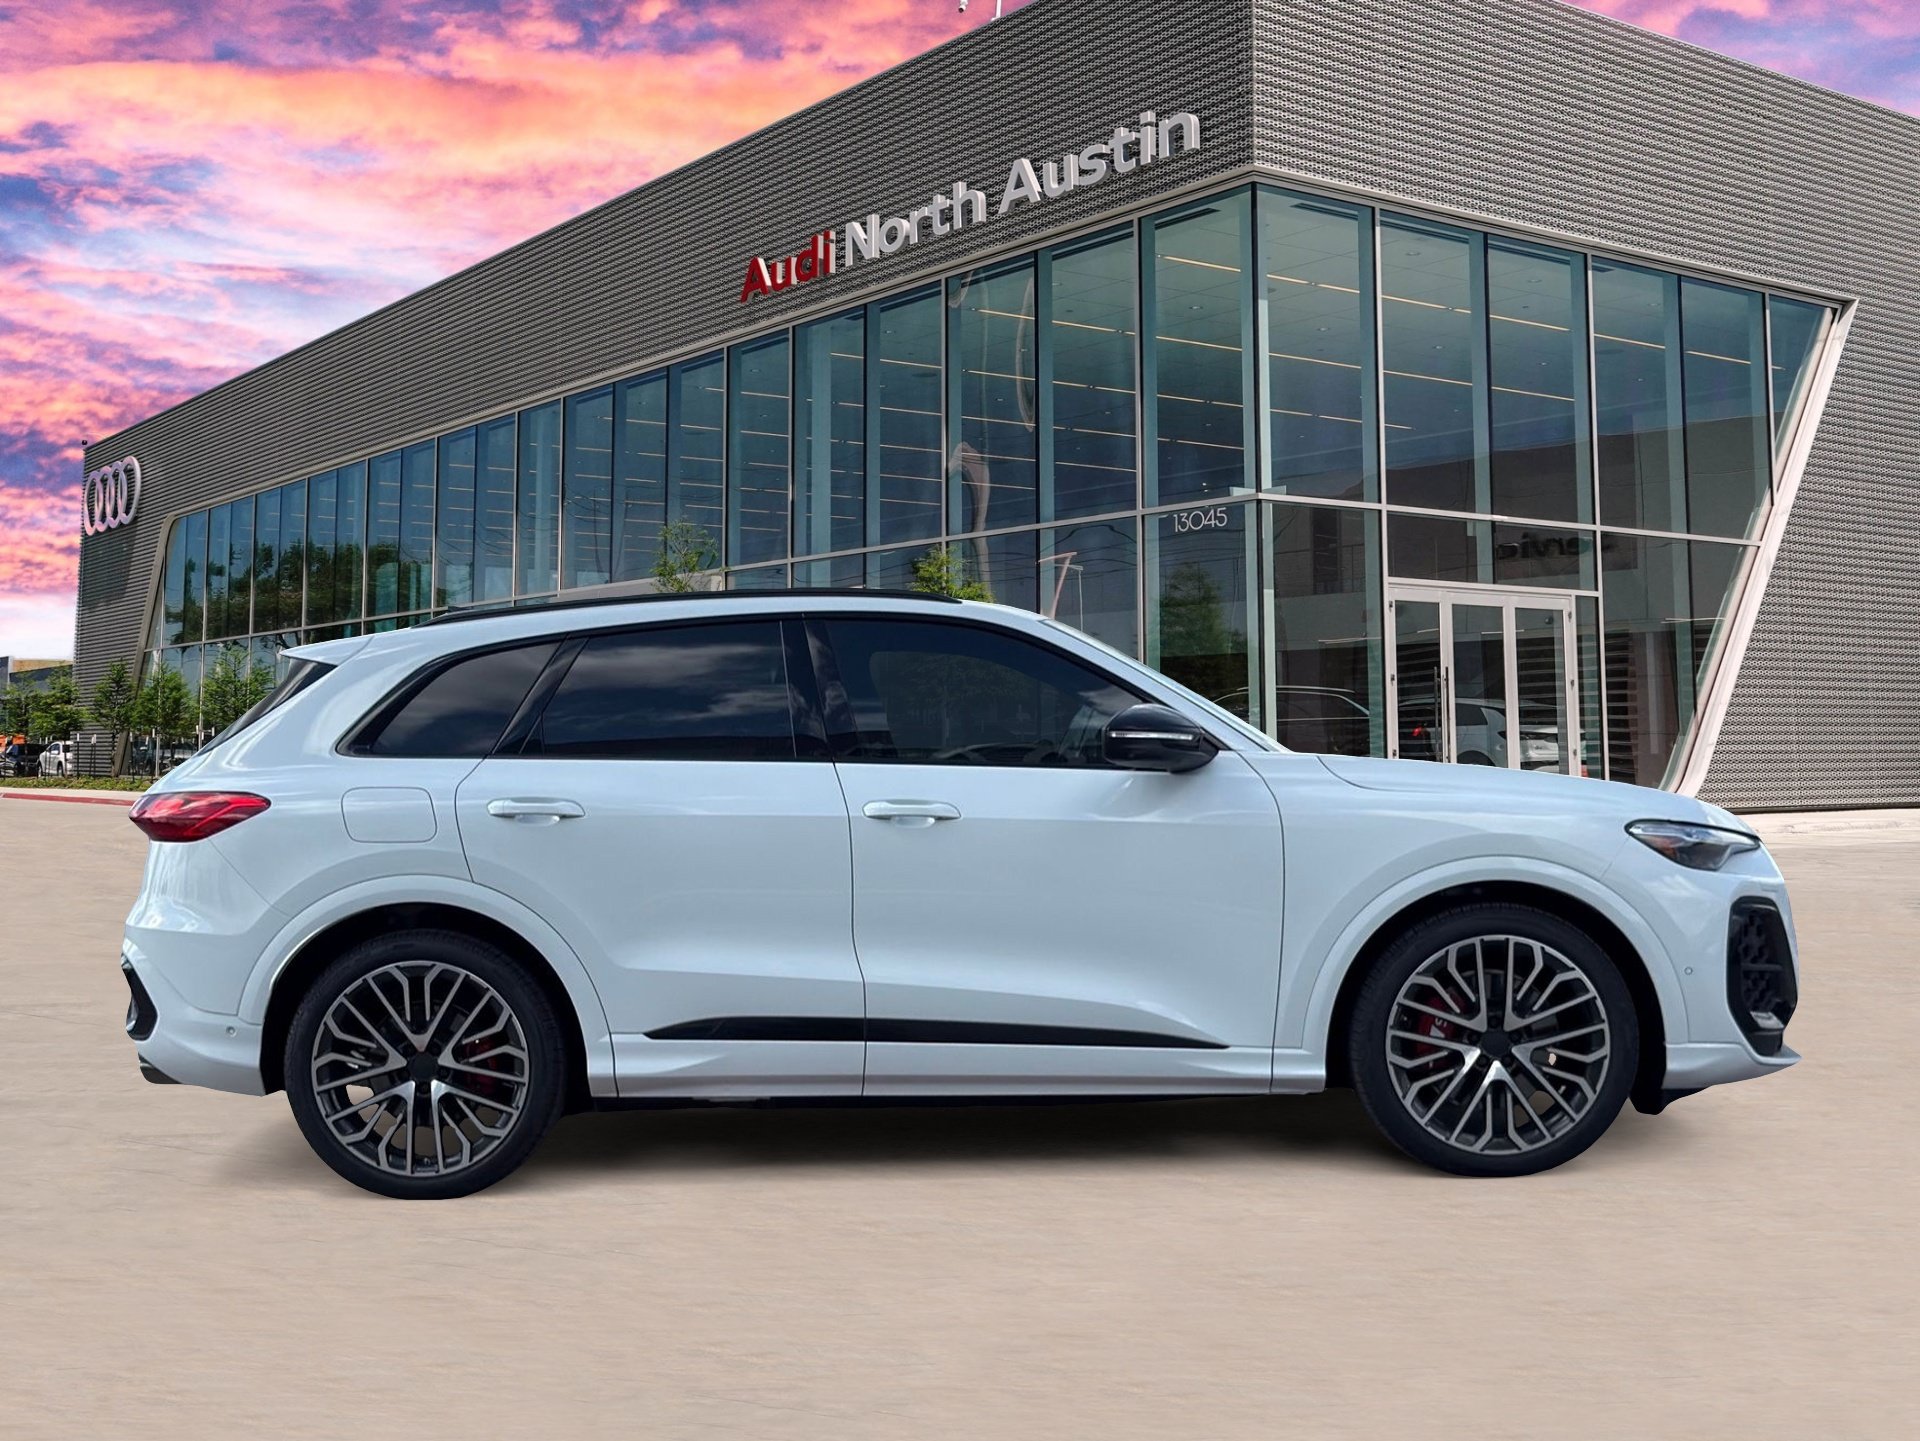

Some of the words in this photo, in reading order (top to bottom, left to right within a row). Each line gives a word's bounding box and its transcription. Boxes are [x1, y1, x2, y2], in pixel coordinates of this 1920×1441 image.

[740, 229, 836, 304] Audi
[845, 181, 987, 267] North
[998, 110, 1200, 214] Austin
[1173, 507, 1228, 532] 13045
